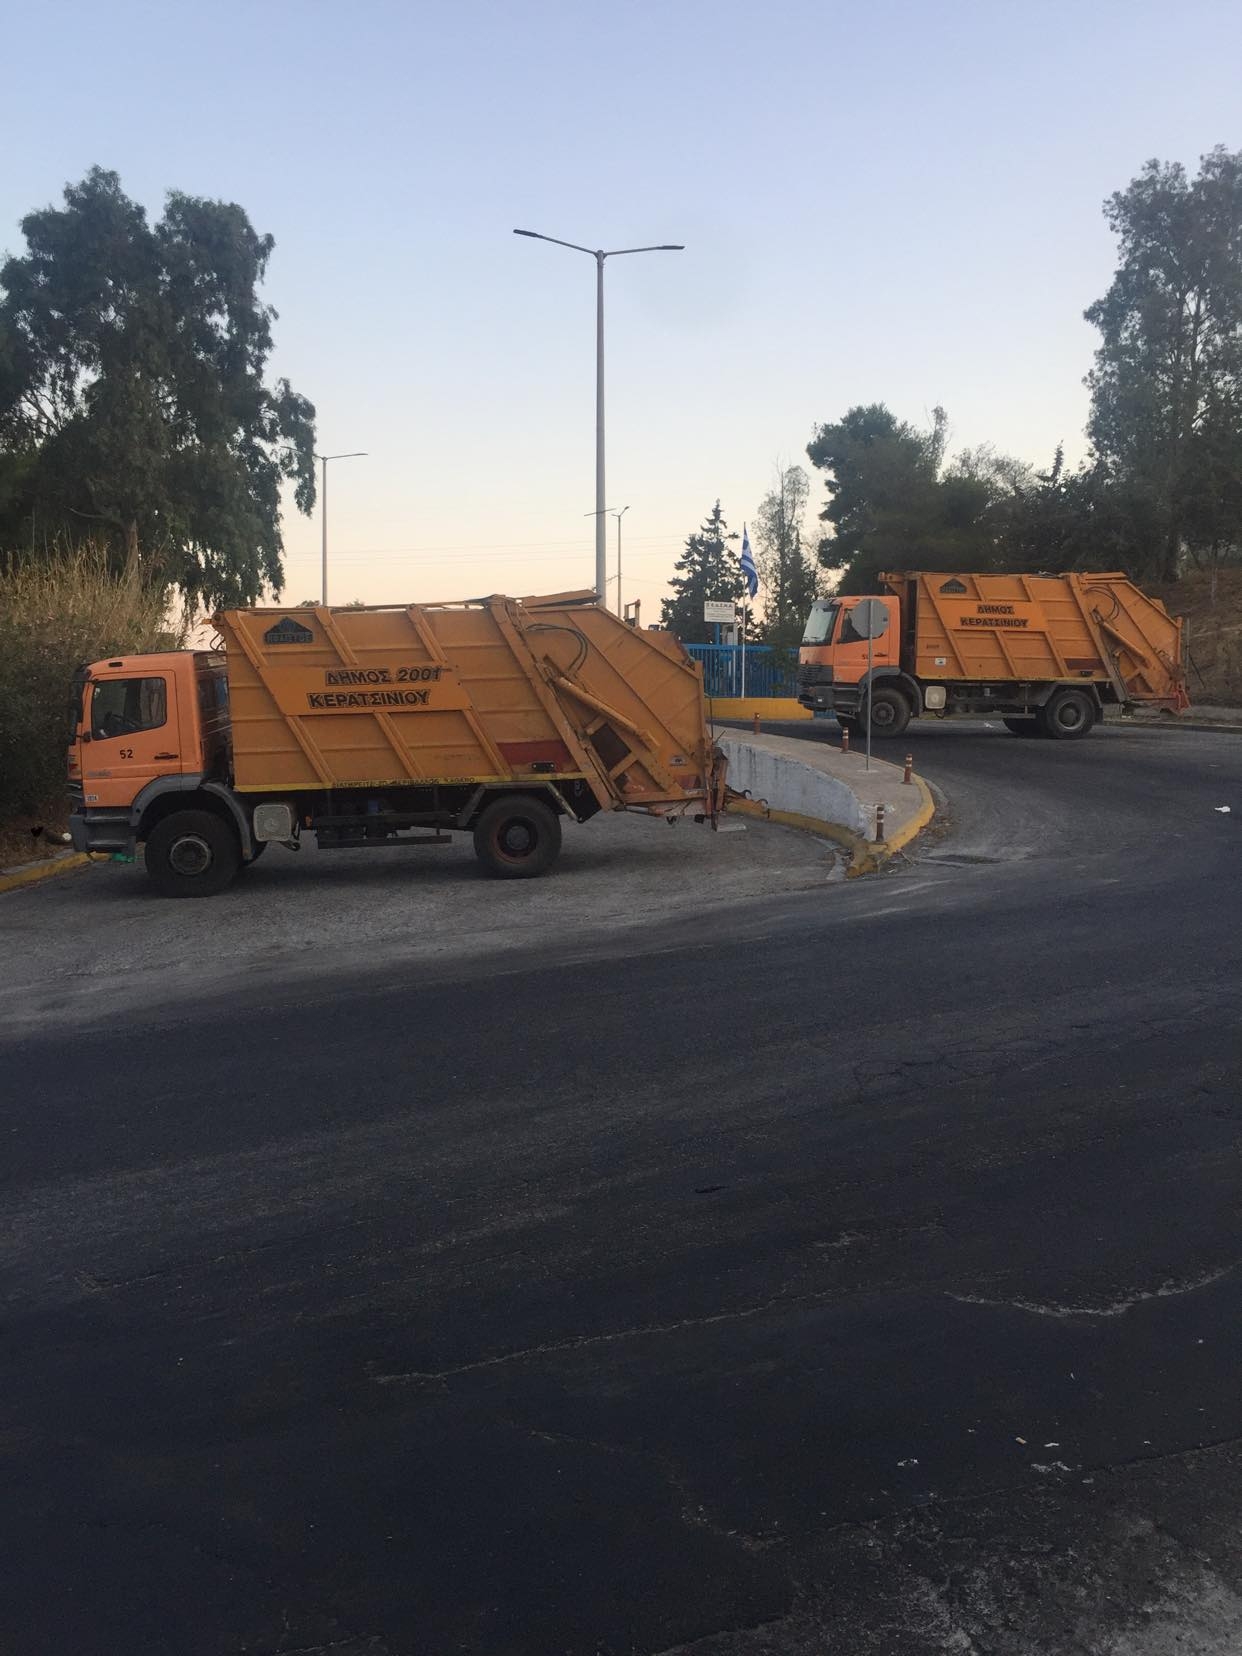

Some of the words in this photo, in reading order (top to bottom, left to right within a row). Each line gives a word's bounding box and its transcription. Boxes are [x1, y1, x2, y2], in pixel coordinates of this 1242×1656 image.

[977, 604, 1016, 615] ΔΗΜΟΣ
[960, 616, 1029, 628] ΚΕΡΑΤΣΙΝΙΟΥ
[327, 670, 392, 685] ΔΗΜΟΣ
[308, 689, 430, 708] ΚΕΡΑΤΣΙΝΙΟΥ
[119, 749, 133, 759] 52
